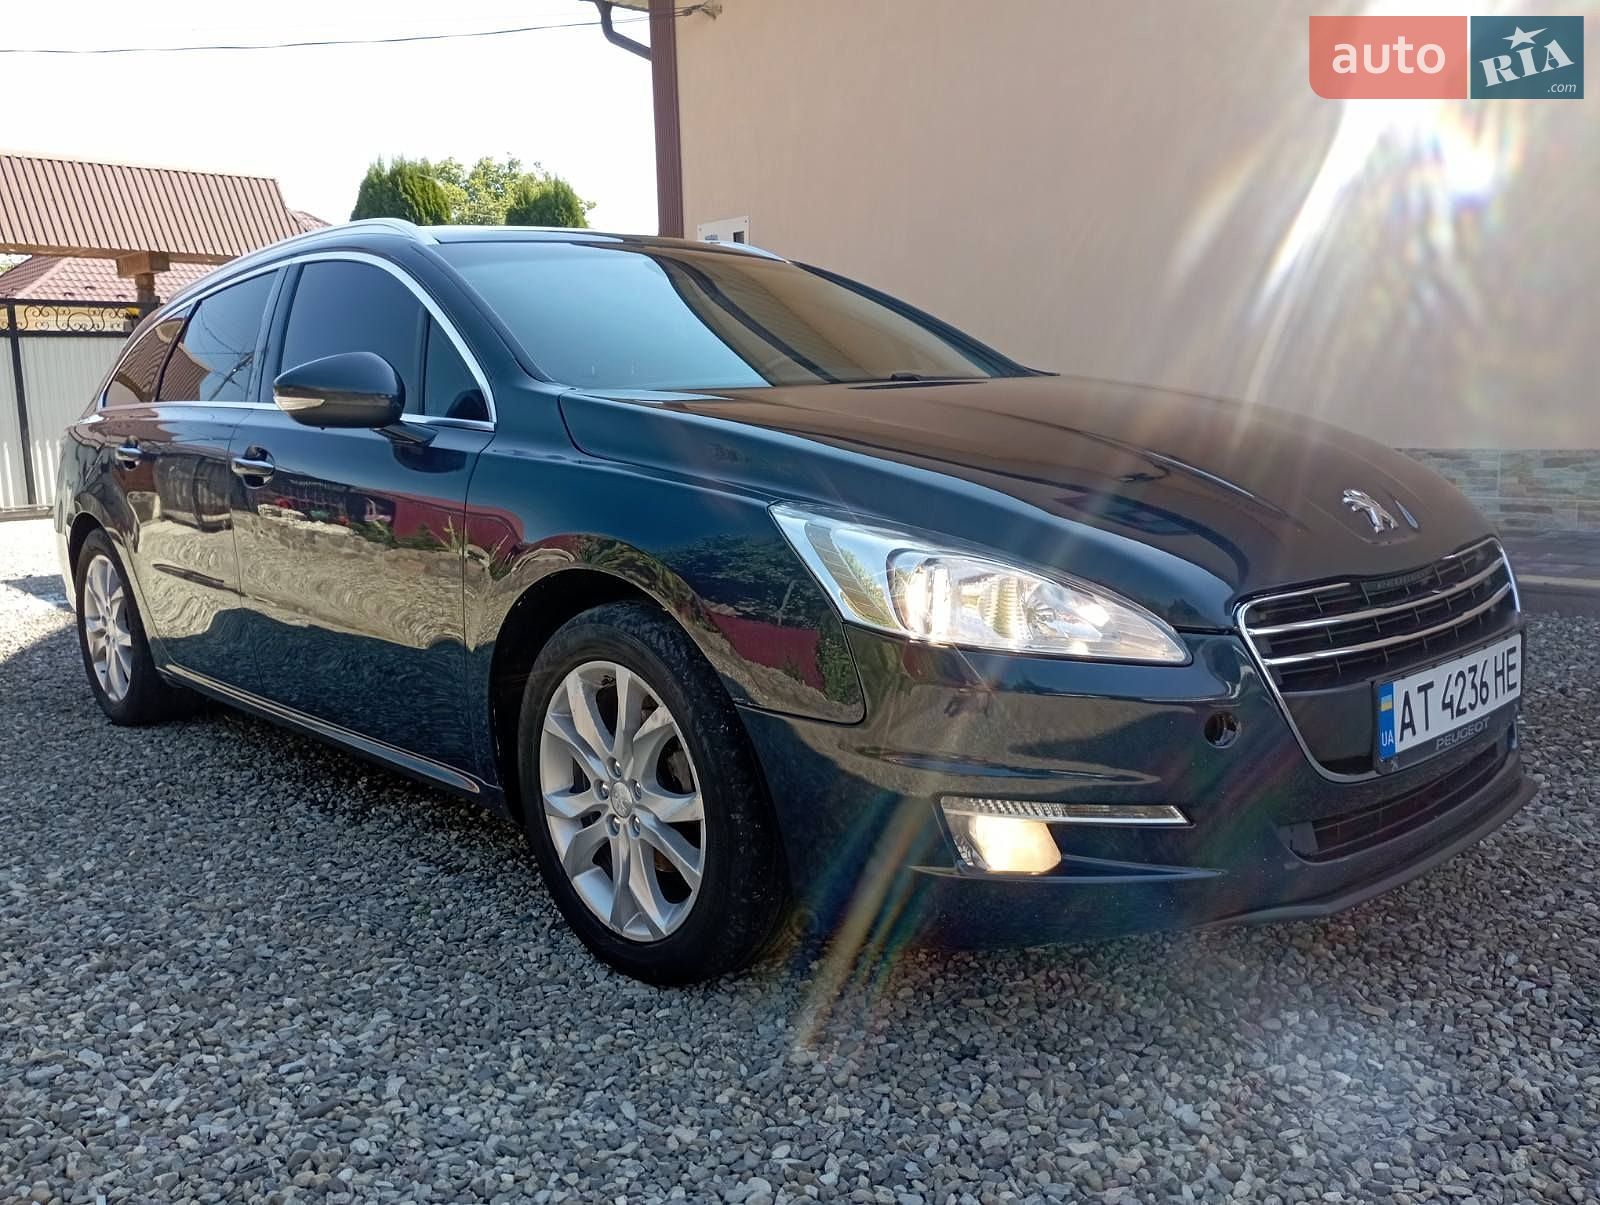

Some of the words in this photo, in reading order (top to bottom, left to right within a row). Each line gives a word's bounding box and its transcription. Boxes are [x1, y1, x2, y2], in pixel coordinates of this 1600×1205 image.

[1399, 681, 1434, 742] AT
[1441, 659, 1489, 720] 4236
[1494, 646, 1517, 699] HE
[1381, 731, 1394, 747] UA
[1436, 716, 1490, 750] PEUGEOT
